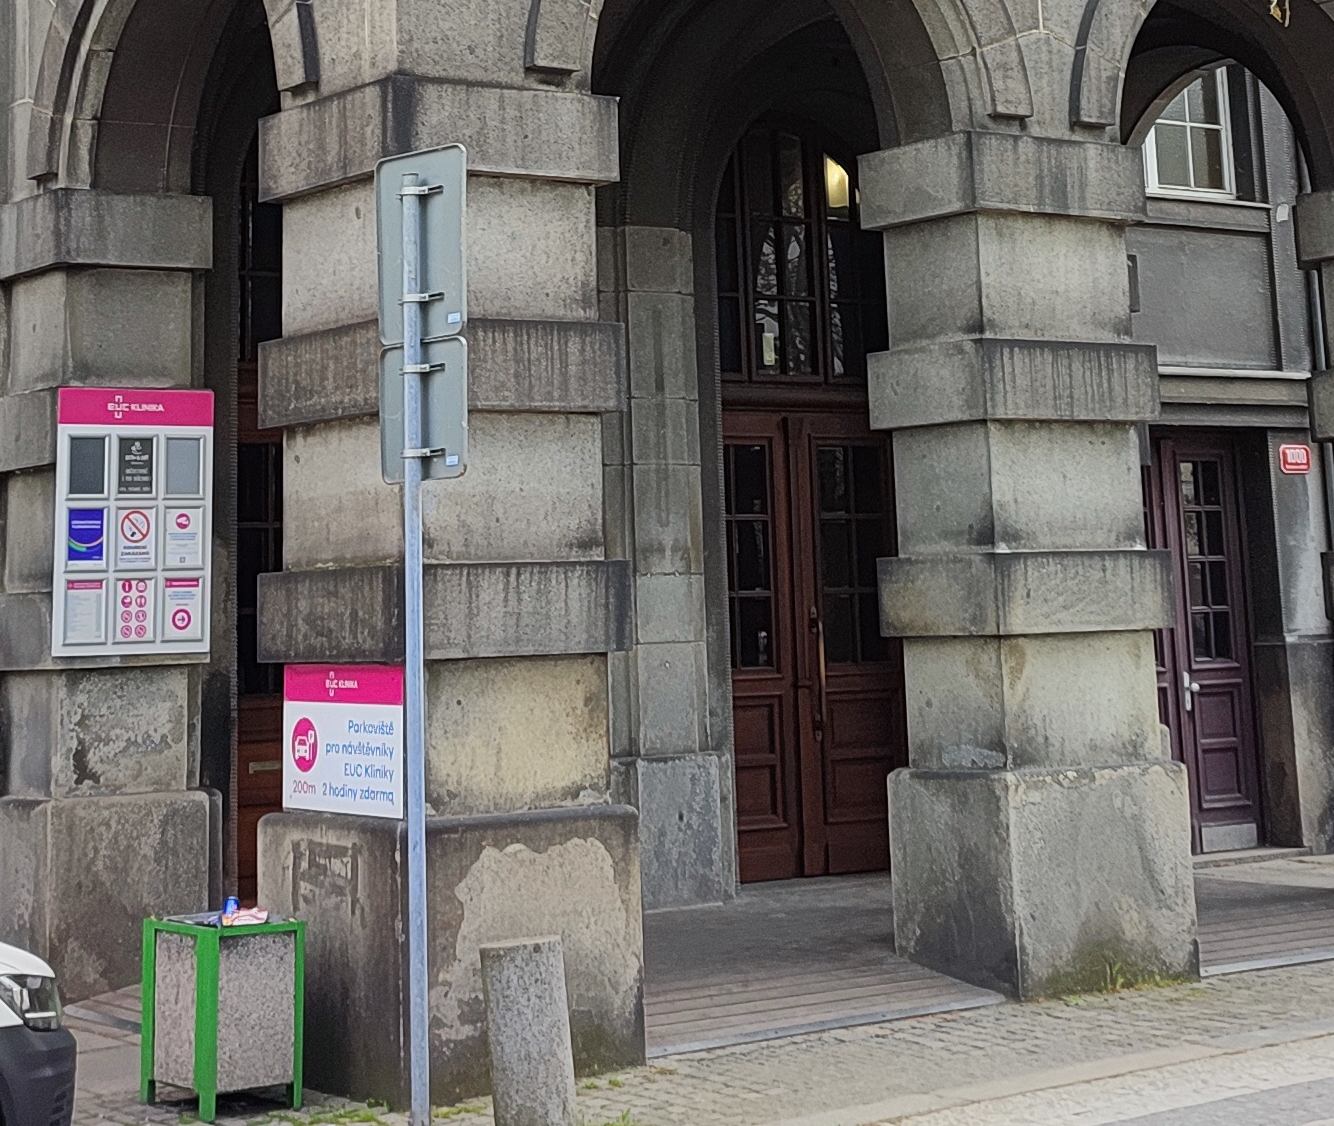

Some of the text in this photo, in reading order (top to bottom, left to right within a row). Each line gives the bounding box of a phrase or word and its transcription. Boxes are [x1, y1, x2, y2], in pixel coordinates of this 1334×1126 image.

[348, 719, 395, 736] Parkoviště
[325, 740, 395, 760] pro návštěvníky
[344, 762, 395, 784] EUC Kliniky
[292, 779, 317, 795] 200m
[328, 783, 358, 802] hodiny
